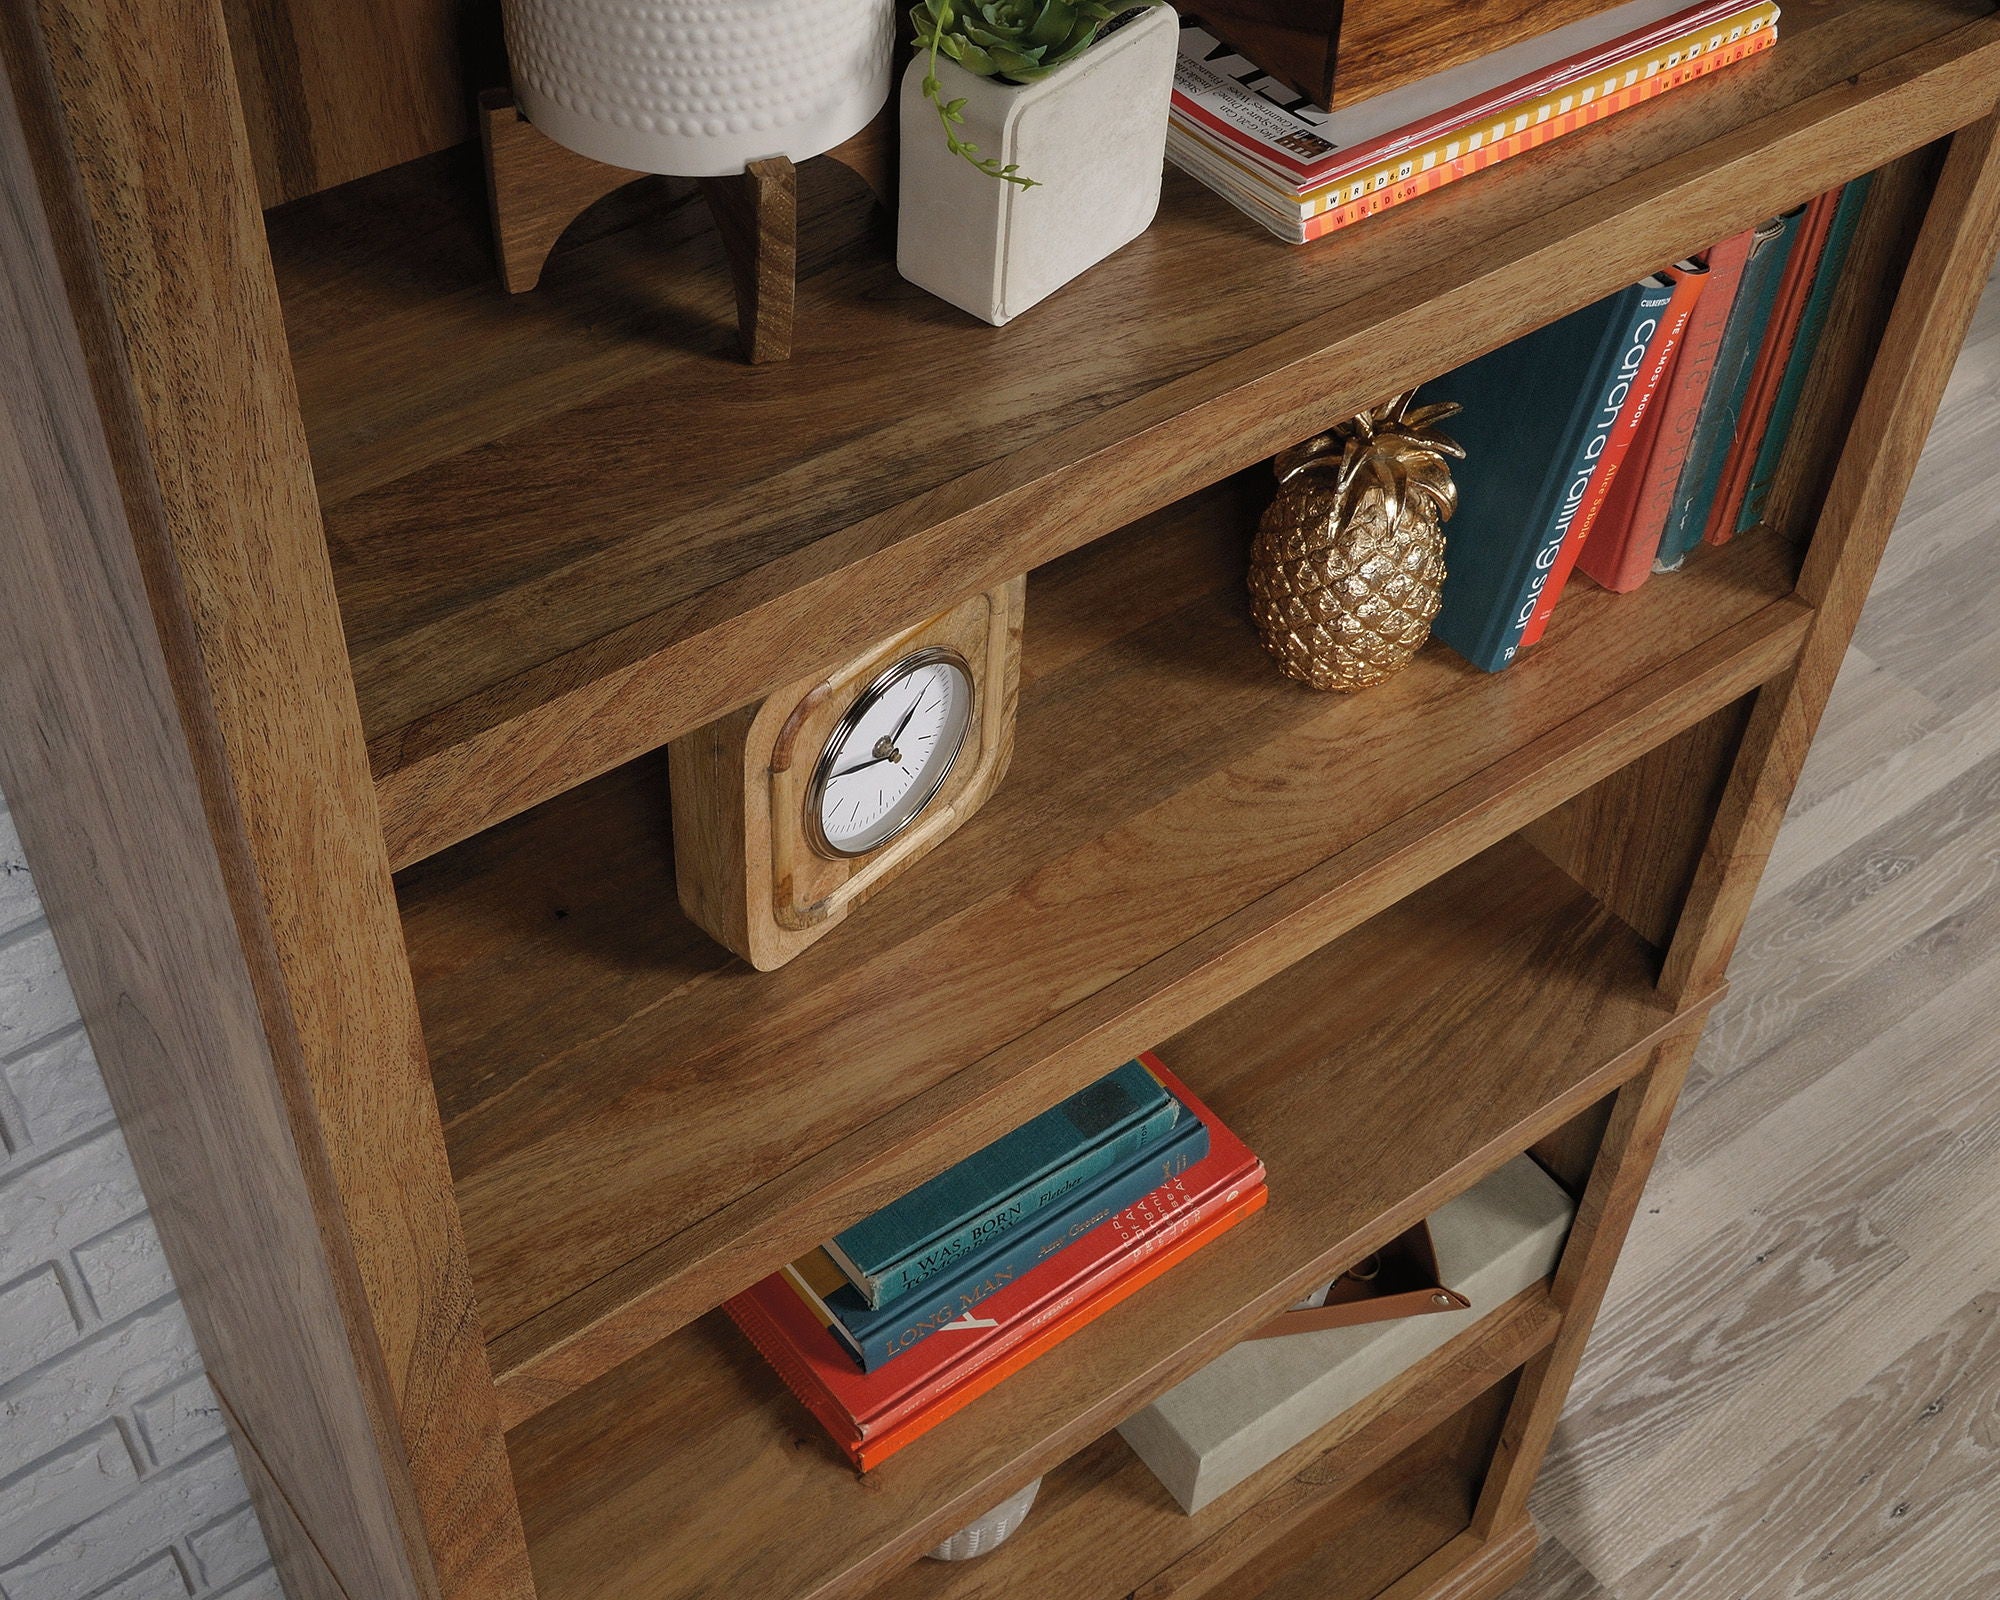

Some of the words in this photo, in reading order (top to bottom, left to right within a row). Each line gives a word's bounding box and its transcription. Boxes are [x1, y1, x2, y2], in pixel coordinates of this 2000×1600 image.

[1218, 105, 1238, 118] Can
[1269, 123, 1287, 135] You
[1329, 177, 1385, 204] WIRED
[1389, 167, 1411, 181] 6.03
[1336, 196, 1391, 225] WIRED
[1397, 186, 1417, 199] 6.01
[1671, 311, 1688, 336] THE
[1597, 318, 1656, 429] catch
[1647, 339, 1674, 389] ALMOST
[1630, 393, 1651, 428] MOON
[1584, 434, 1607, 460] a
[1598, 463, 1617, 496] Alice
[1578, 498, 1603, 540] Sebold
[901, 1270, 908, 1282] I
[917, 1239, 961, 1271] WAS
[970, 1202, 1023, 1240] BORN
[1038, 1176, 1083, 1207] Fletcher
[886, 1305, 953, 1357] LONG
[960, 1265, 1014, 1310] MAN
